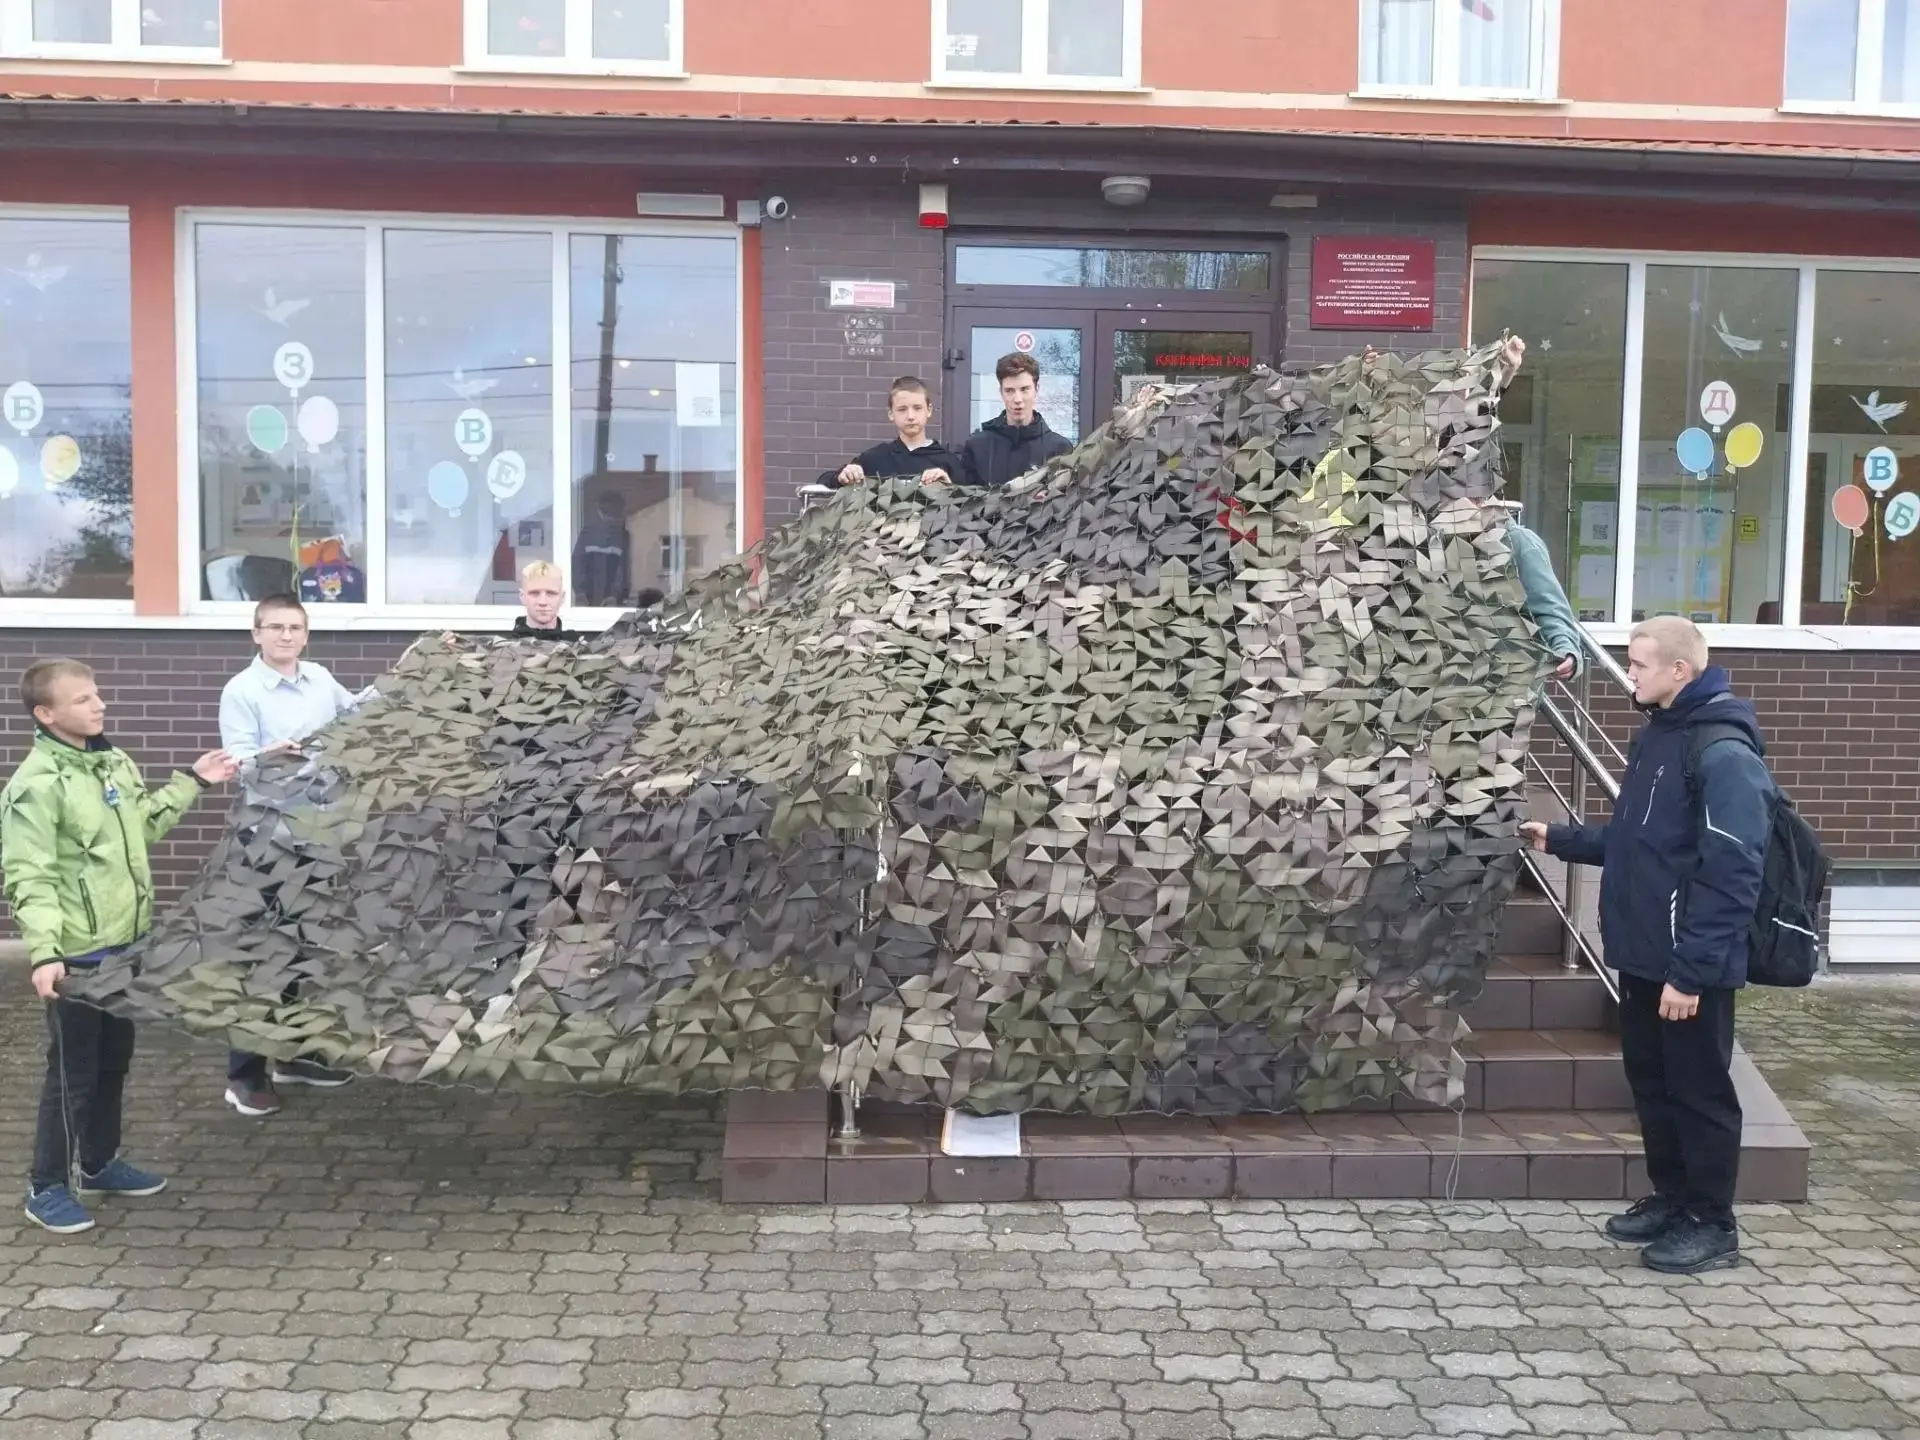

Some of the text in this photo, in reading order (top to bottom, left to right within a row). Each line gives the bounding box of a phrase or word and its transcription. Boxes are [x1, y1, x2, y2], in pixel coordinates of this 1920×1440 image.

[9, 395, 37, 421] Б
[1704, 389, 1729, 415] Д
[460, 418, 486, 443] В
[1868, 456, 1891, 480] В
[1887, 501, 1914, 530] Б
